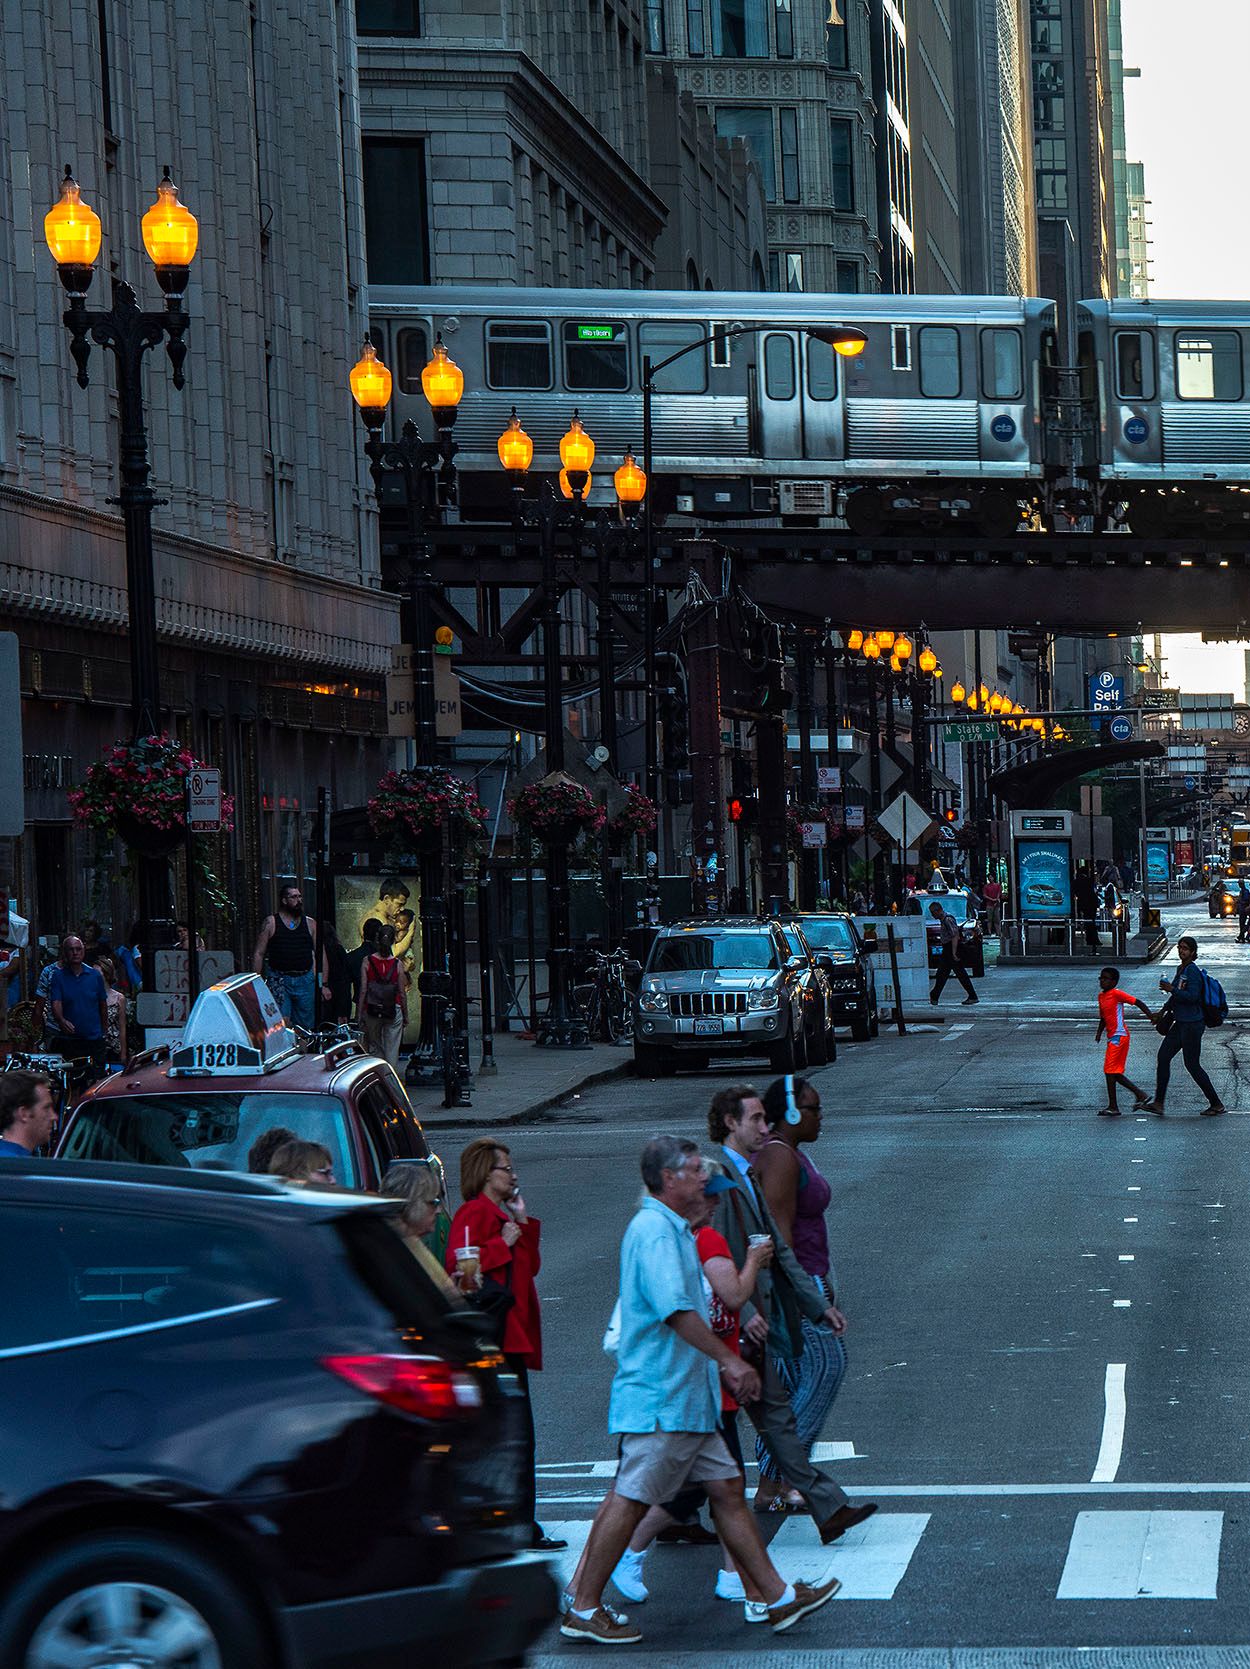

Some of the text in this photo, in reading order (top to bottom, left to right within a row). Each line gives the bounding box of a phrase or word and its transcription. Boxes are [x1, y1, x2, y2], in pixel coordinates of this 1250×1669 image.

[995, 425, 1013, 433] cta
[1128, 426, 1146, 435] cta
[392, 656, 409, 669] JE
[1095, 690, 1120, 700] Self
[389, 701, 416, 715] JEM
[1094, 703, 1122, 711] Pak
[946, 723, 995, 734] N State St
[1114, 724, 1129, 732] cta
[195, 1044, 236, 1066] 1328
